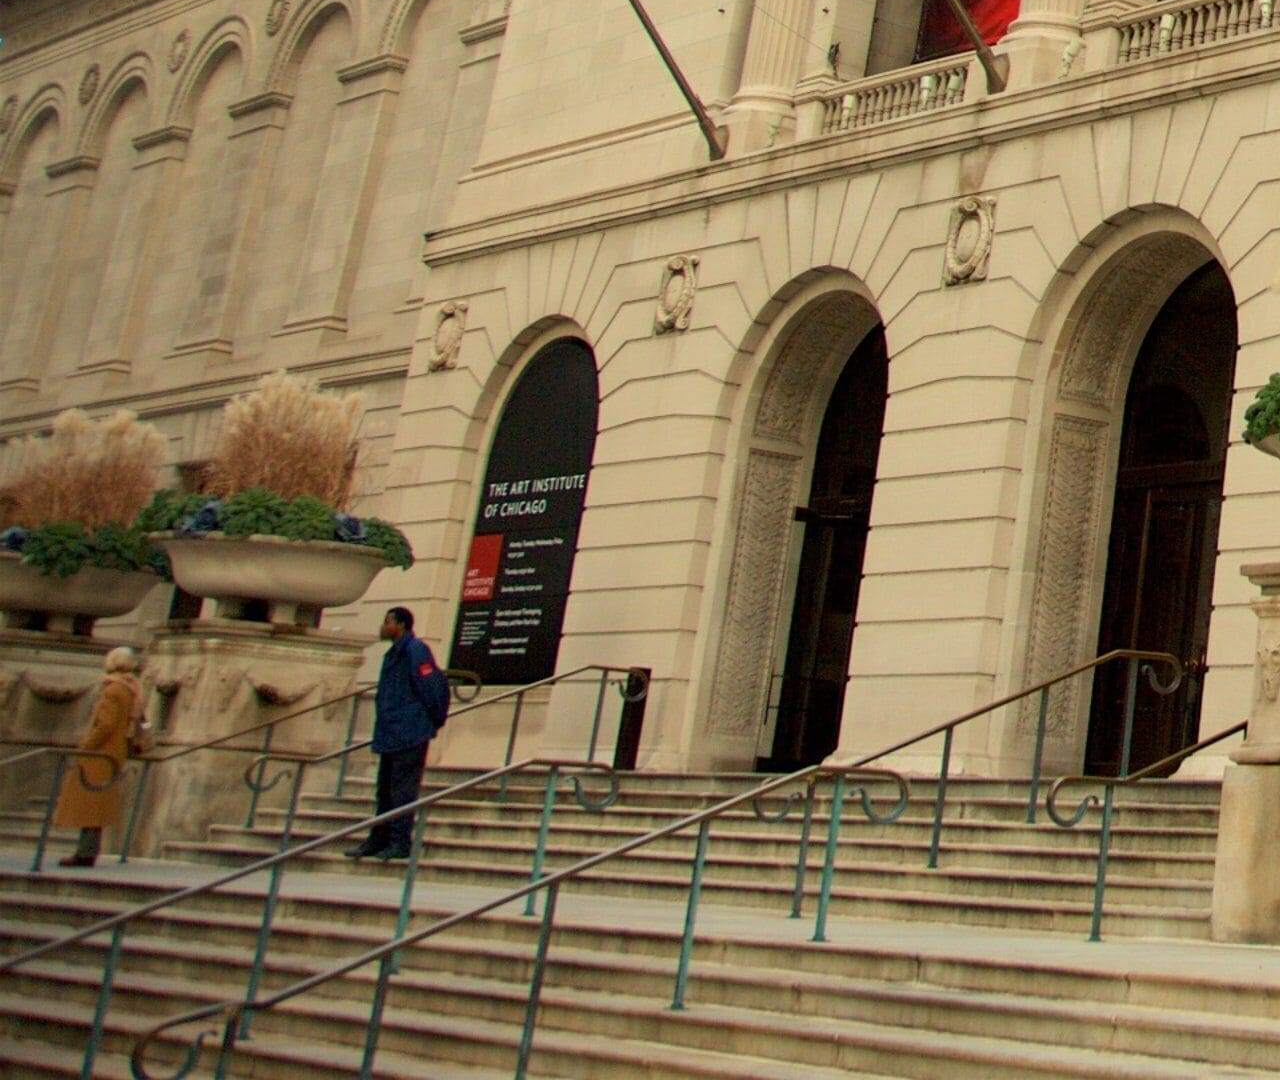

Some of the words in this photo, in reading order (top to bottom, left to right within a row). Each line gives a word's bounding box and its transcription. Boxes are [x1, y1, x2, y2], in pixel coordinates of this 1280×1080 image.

[489, 482, 509, 497] THE
[510, 480, 530, 495] ART
[531, 474, 586, 493] INSTITUTE
[484, 503, 499, 518] OF
[500, 499, 547, 517] CHICAGO
